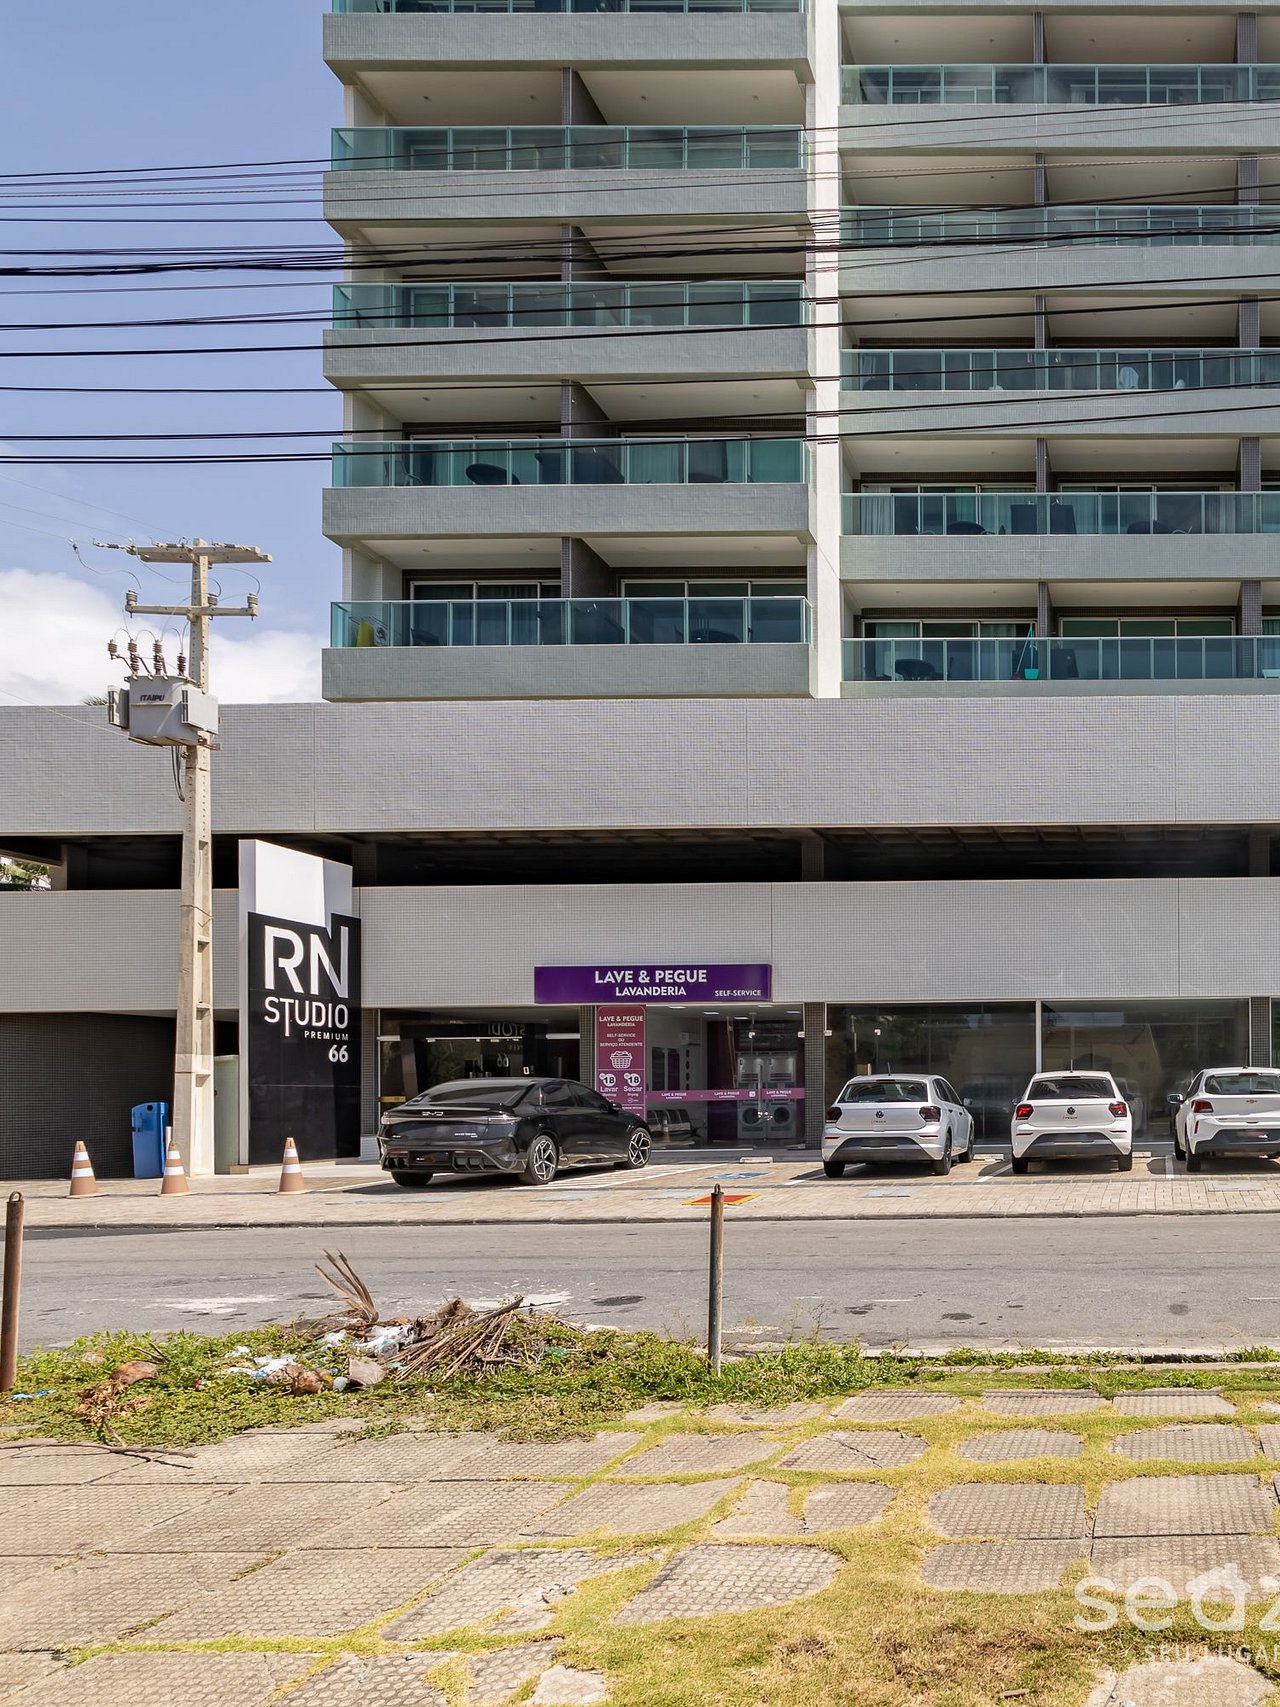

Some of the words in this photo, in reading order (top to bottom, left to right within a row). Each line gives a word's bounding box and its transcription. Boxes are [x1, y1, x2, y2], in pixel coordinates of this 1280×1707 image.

[140, 694, 165, 702] ITAIPU
[264, 925, 349, 998] RN
[594, 971, 633, 984] LAVE
[638, 971, 650, 984] &
[655, 970, 707, 983] PEGUE
[615, 987, 687, 996] LAVANDERIA
[264, 996, 349, 1037] STUDIO
[304, 1030, 349, 1041] PREMIUM
[328, 1044, 349, 1063] 66
